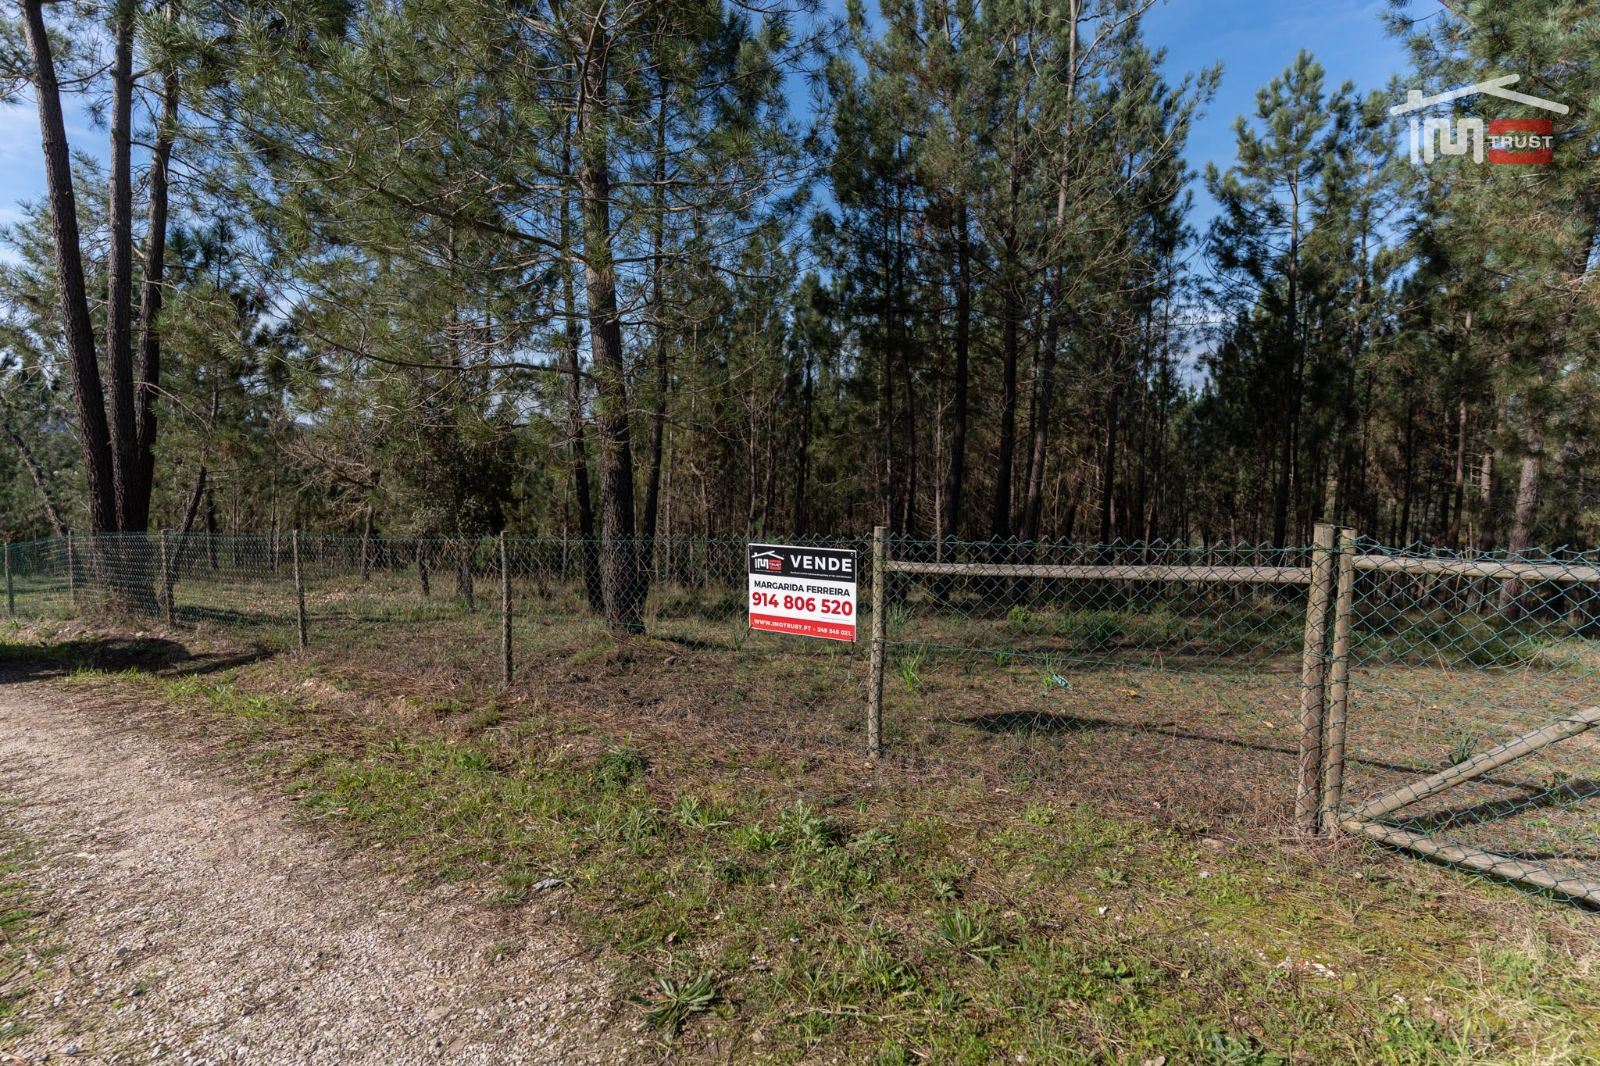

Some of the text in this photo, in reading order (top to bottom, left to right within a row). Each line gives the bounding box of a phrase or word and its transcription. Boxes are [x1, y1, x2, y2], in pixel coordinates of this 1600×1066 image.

[790, 554, 853, 572] VENDE
[754, 580, 850, 597] MARGARIDA FERREIRA
[752, 592, 853, 616] 914 806 520
[754, 618, 811, 631] WWW.IMOTRUST.PT
